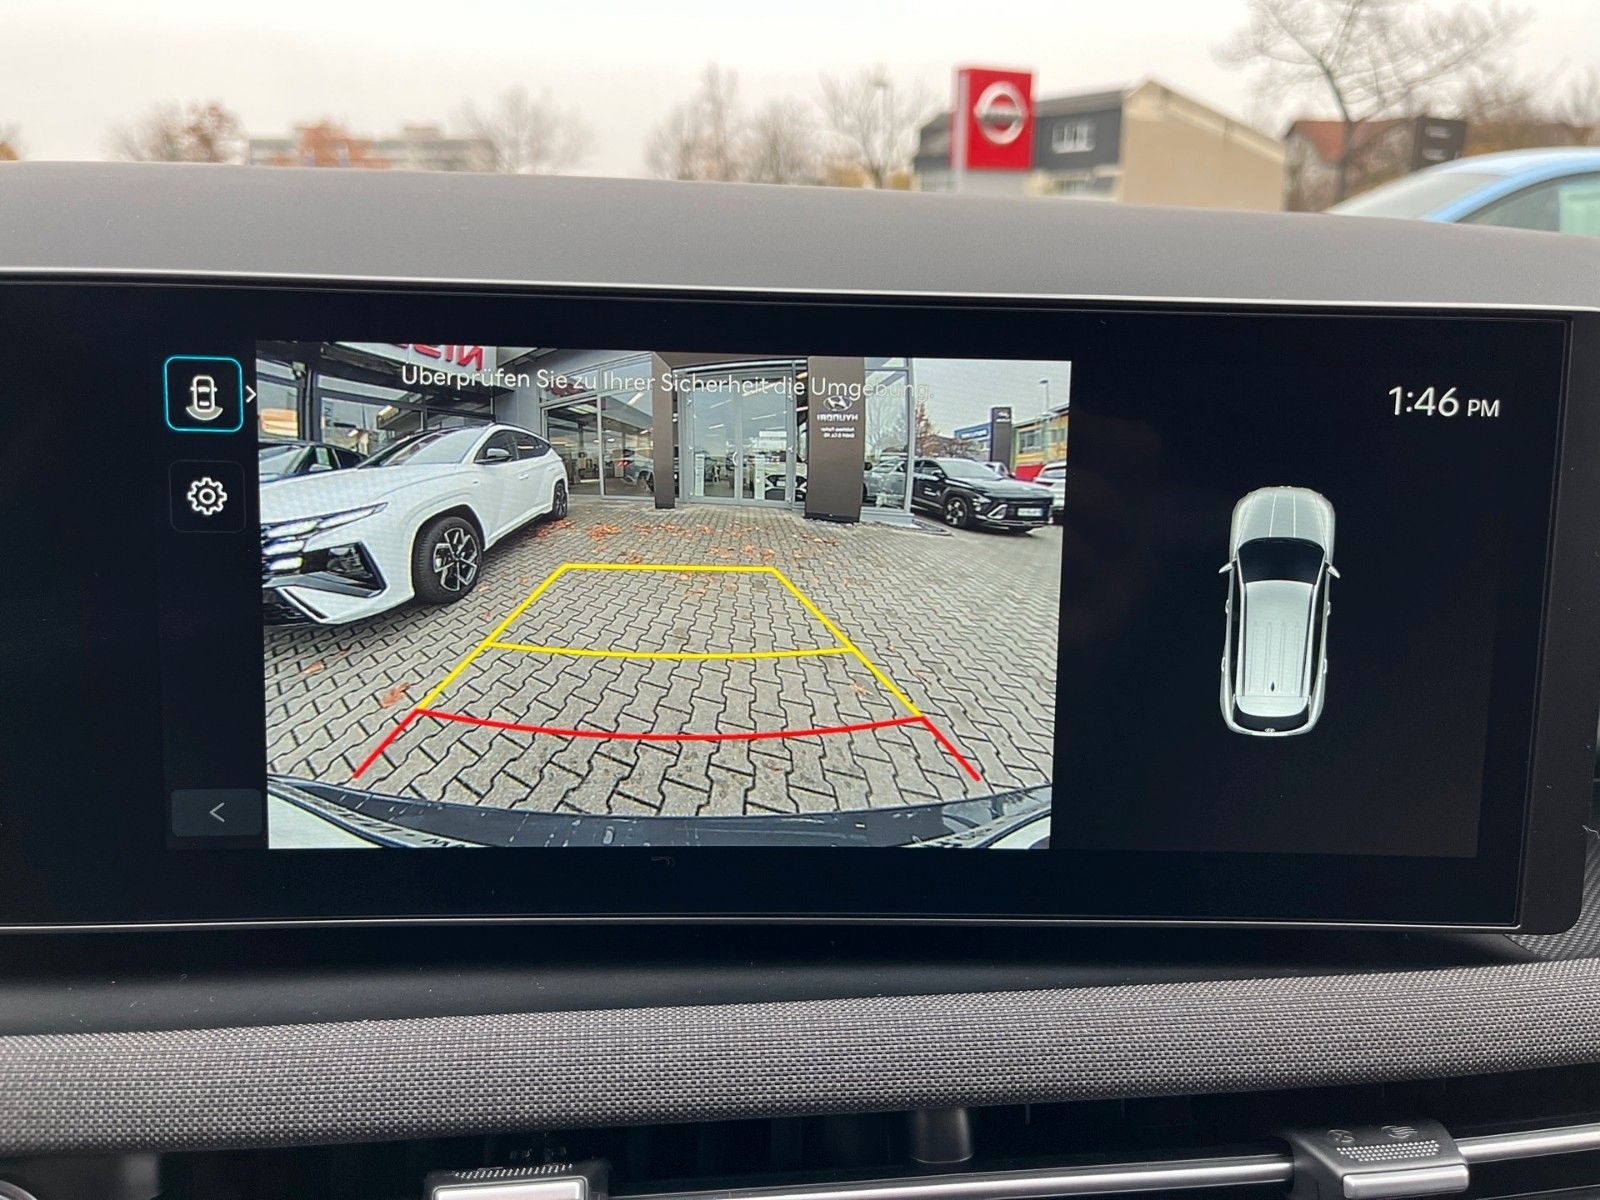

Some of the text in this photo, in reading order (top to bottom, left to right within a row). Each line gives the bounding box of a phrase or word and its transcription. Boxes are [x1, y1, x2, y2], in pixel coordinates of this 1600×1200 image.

[401, 361, 934, 402] Überprüfen Sie zu Ihrer Sicherheit die Umgebung.
[1388, 386, 1500, 417] 1:46 PM
